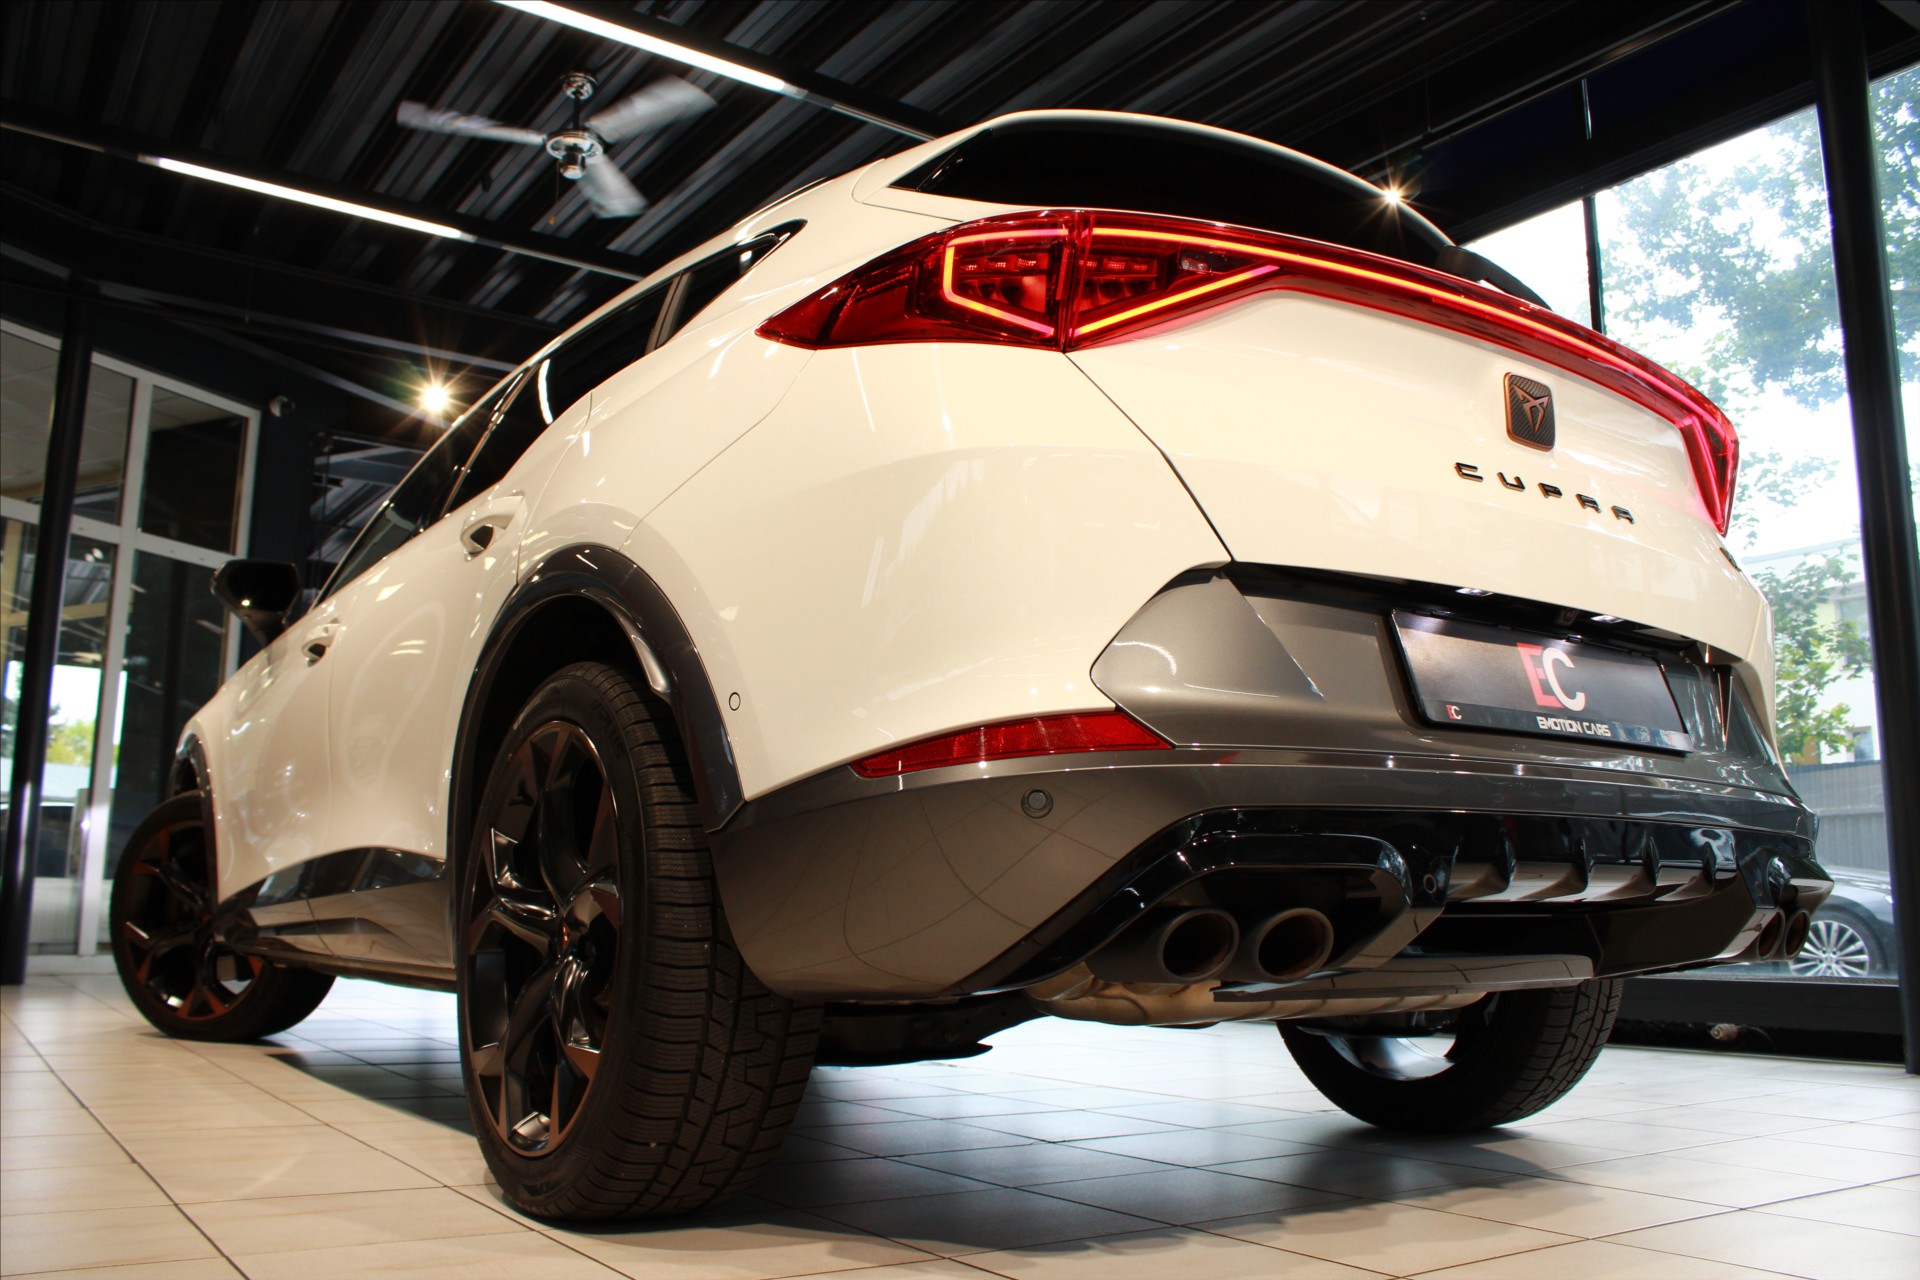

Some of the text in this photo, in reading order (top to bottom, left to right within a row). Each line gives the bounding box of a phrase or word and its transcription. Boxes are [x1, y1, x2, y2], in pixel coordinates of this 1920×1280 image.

[1454, 462, 1634, 525] CUPRA
[1516, 642, 1586, 712] EC
[1536, 716, 1611, 736] EMOTION CARS
